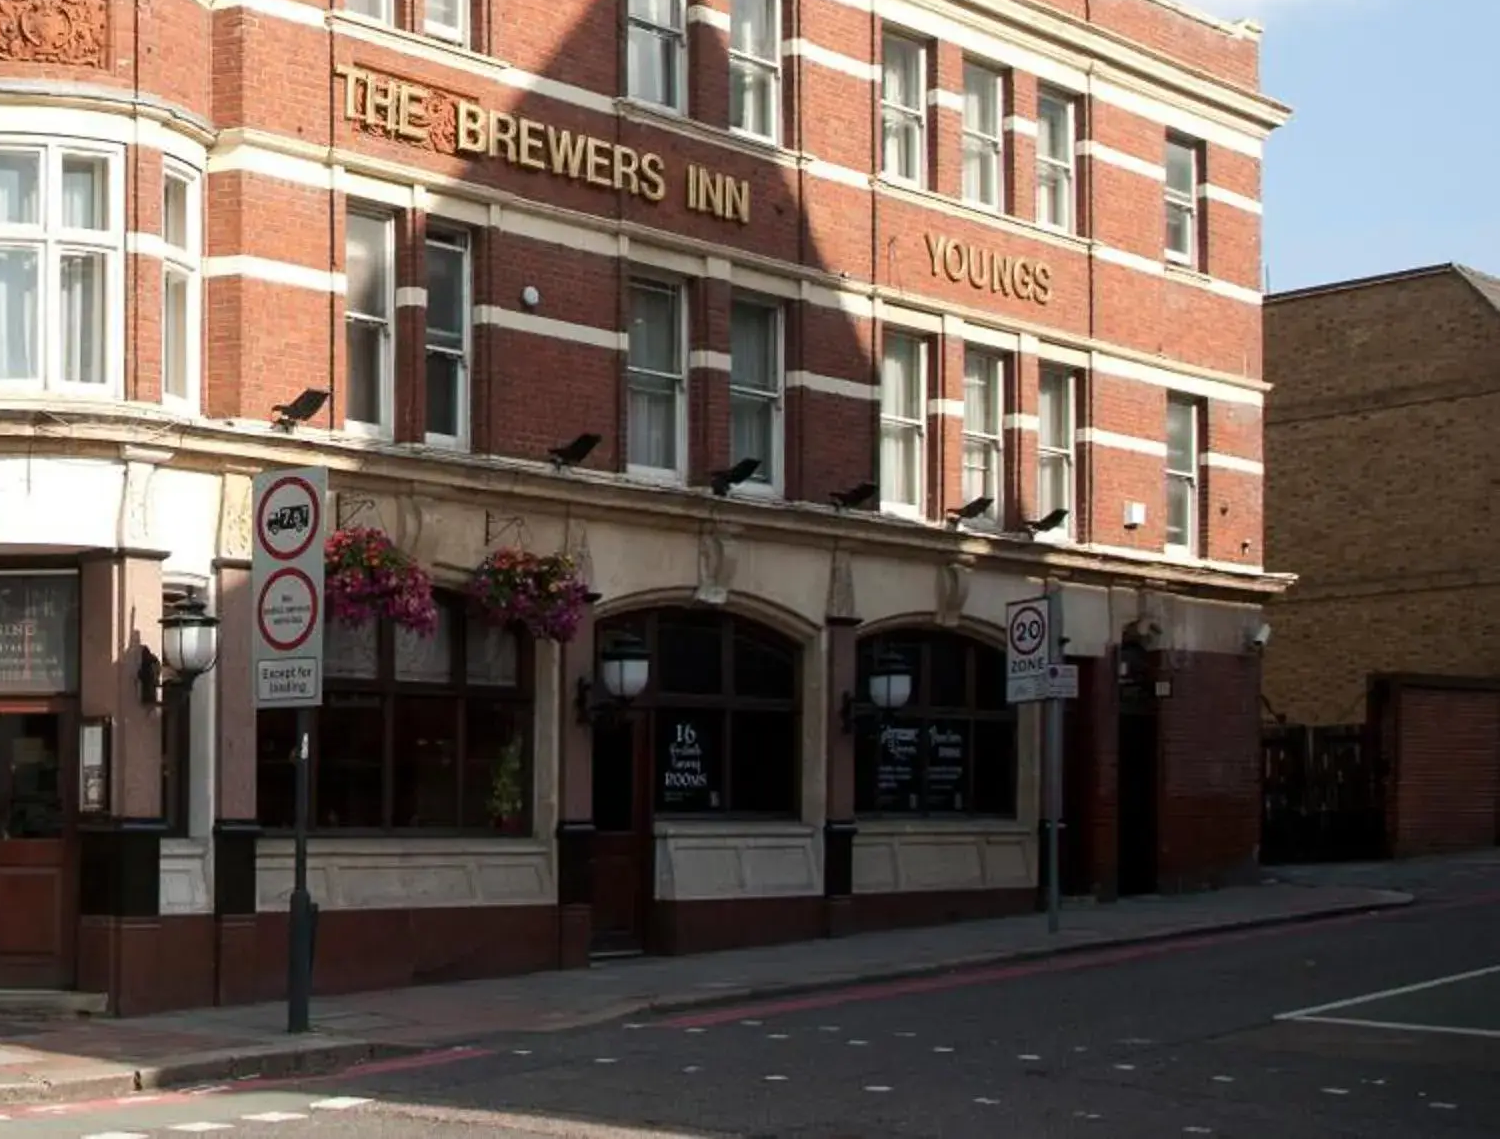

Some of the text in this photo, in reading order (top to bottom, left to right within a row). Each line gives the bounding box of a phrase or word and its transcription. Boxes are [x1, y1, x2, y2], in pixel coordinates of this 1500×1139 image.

[334, 63, 750, 224] THE BREWERS INN
[923, 230, 1052, 305] YOUNGS
[1016, 620, 1040, 642] 20
[262, 666, 297, 680] Except
[1011, 656, 1045, 673] ZONE
[675, 724, 697, 744] 16
